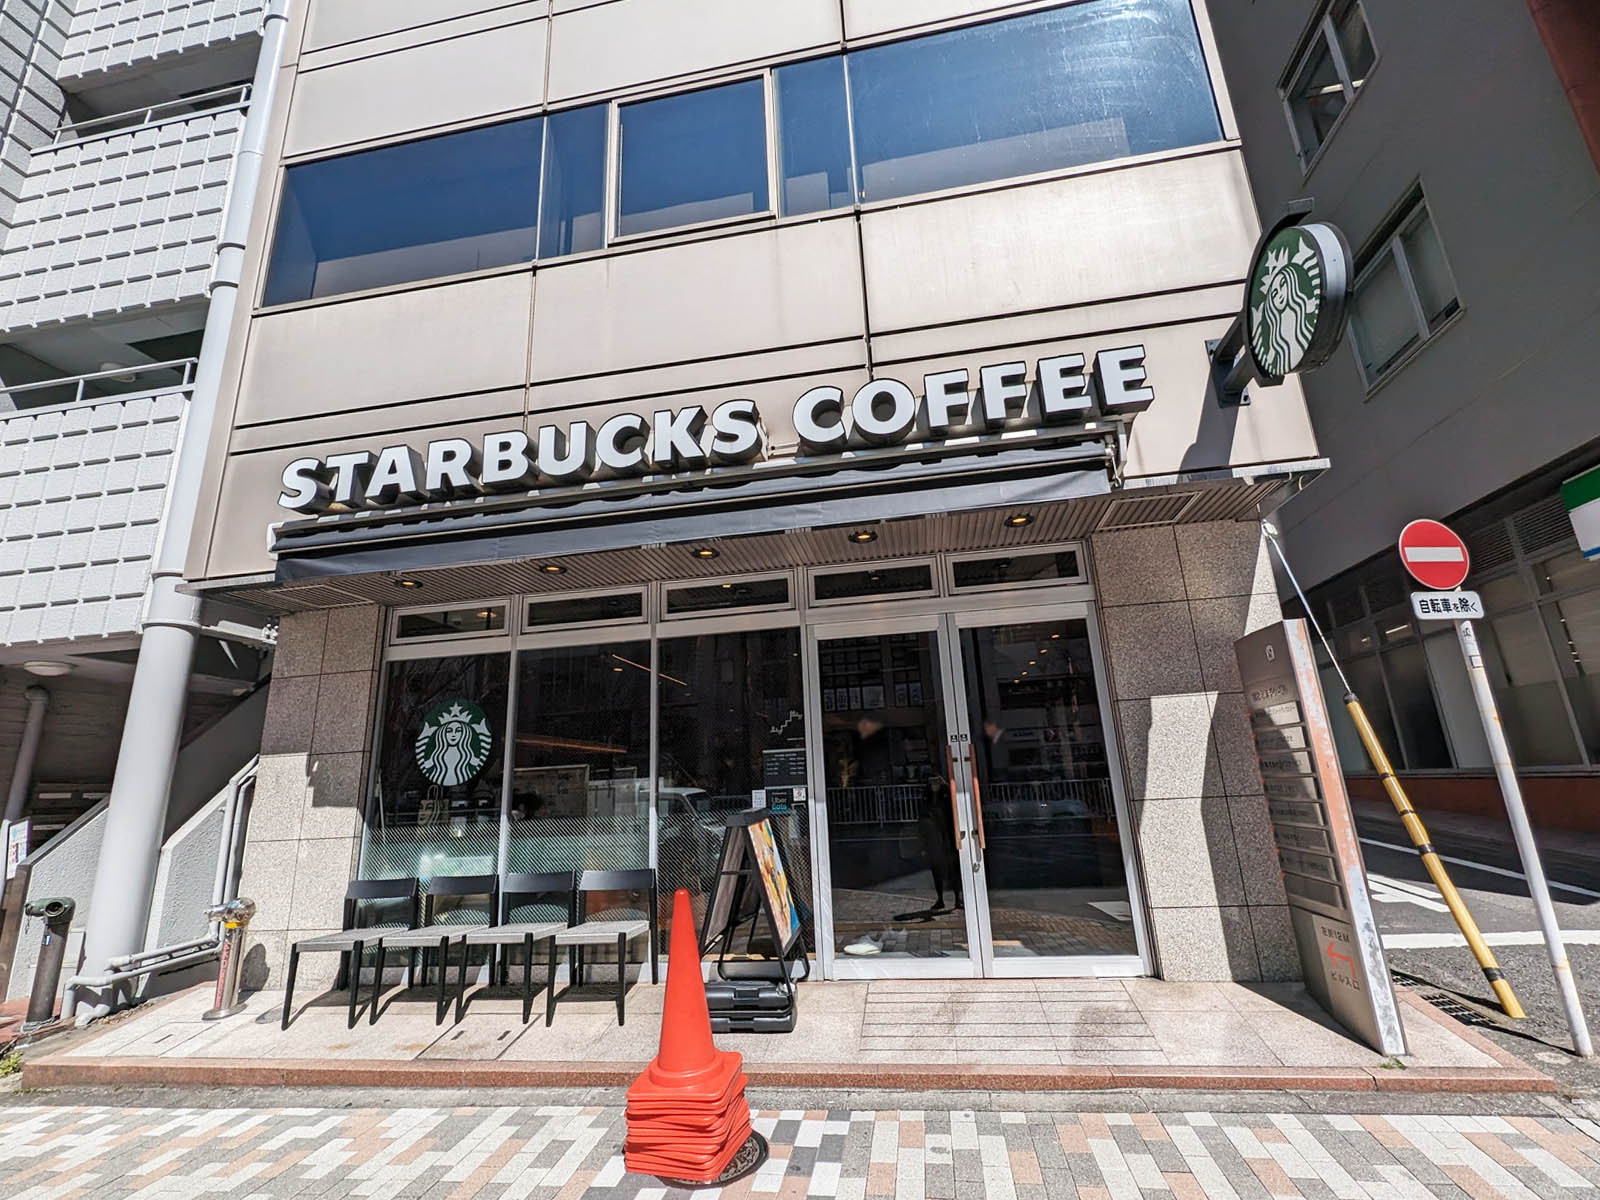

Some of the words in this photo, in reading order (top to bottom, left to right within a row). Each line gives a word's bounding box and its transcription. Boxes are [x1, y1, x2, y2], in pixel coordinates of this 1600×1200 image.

[277, 398, 759, 510] STARBUCKS
[792, 345, 1154, 443] COFFEE
[1419, 597, 1478, 613] 自転車を除く
